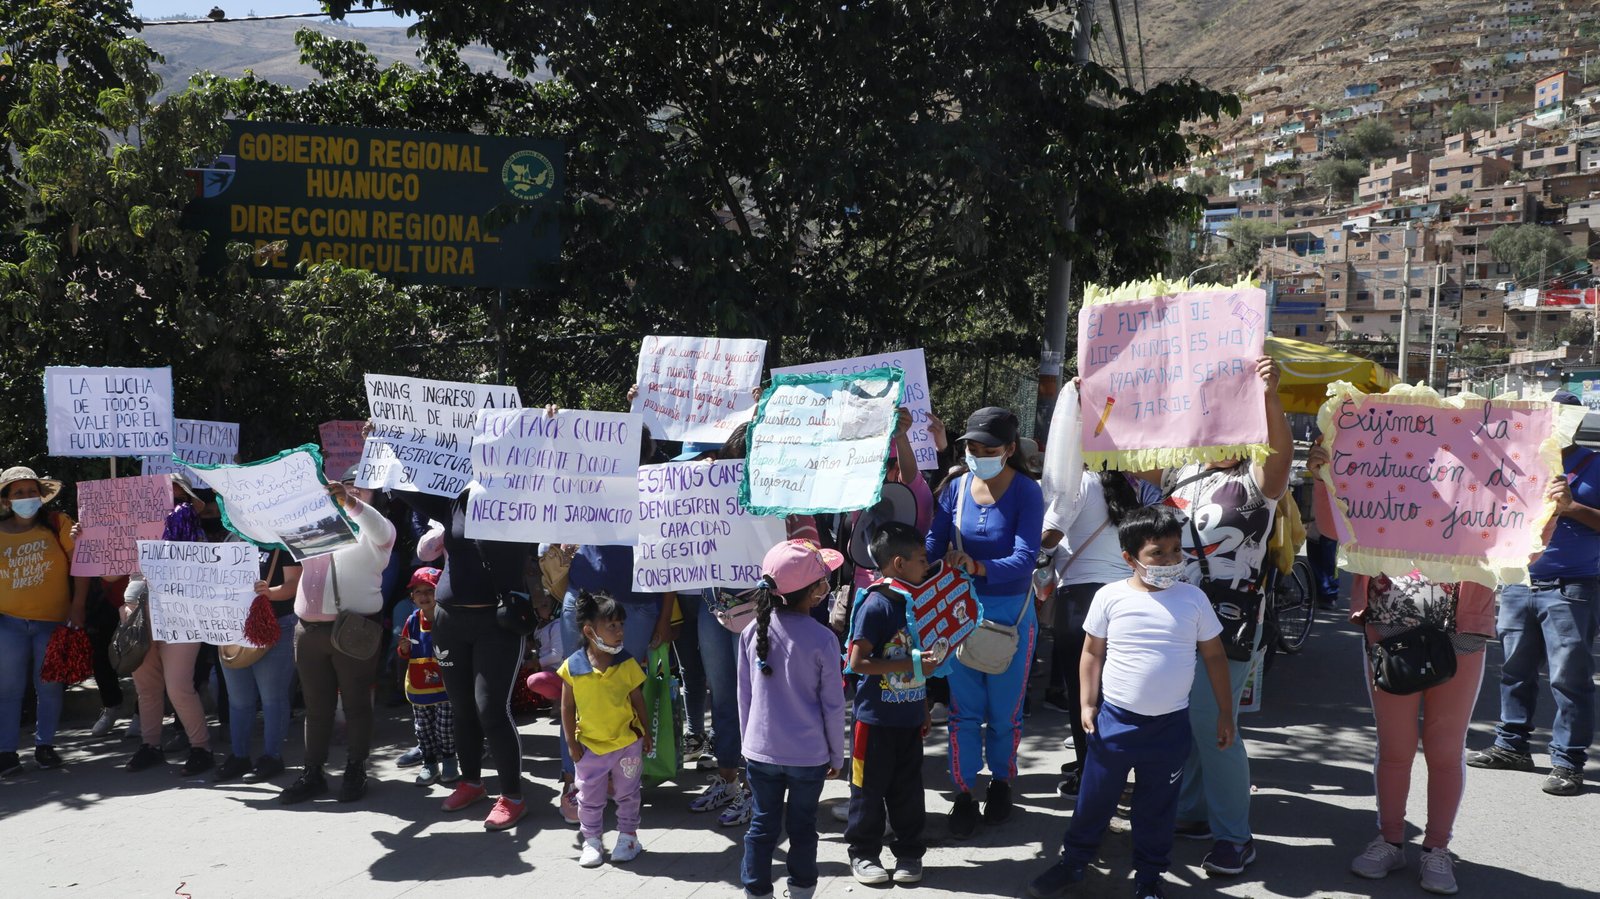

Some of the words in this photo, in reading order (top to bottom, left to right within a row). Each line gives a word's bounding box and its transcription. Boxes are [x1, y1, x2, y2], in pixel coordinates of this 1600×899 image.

[239, 132, 360, 166] GOBIERNO
[369, 138, 489, 174] REGIONAL
[307, 168, 420, 201] HUANUCO
[510, 188, 544, 200] HUANUCO
[231, 204, 368, 238] DIRECCION
[299, 241, 476, 275] AGRICULTURA
[1087, 313, 1104, 340] EL
[1117, 306, 1180, 335] FUTURO
[1190, 301, 1213, 321] DE
[1090, 344, 1120, 366] LOS
[1131, 336, 1182, 360] NIÑOS
[1189, 332, 1208, 352] ES
[1218, 328, 1256, 348] HOY
[69, 377, 92, 395] LA
[105, 377, 155, 394] LUCHA
[1110, 365, 1183, 394] MAÑANA
[1192, 359, 1245, 384] SERA
[74, 399, 89, 414] DE
[101, 396, 149, 411] TODOS
[422, 386, 476, 408] INGRESO
[483, 392, 495, 409] A
[1131, 395, 1193, 420] TARDE
[73, 415, 109, 430] VALE
[116, 412, 140, 428] POR
[143, 412, 160, 427] EL
[372, 400, 417, 423] CAPITAL
[427, 408, 443, 426] DE
[1338, 399, 1437, 445] Exijimos
[1471, 401, 1511, 440] la
[70, 432, 115, 449] FUTURO
[371, 423, 405, 440] URGE
[410, 427, 428, 444] DE
[435, 432, 458, 452] UNA
[482, 415, 516, 439] POR
[519, 415, 567, 440] FAVOR
[573, 417, 629, 445] QUIERO
[481, 444, 500, 467] UN
[505, 445, 569, 470] AMBIENTE
[577, 452, 621, 475] DONDE
[399, 466, 418, 484] SU
[479, 472, 496, 489] ME
[503, 472, 547, 492] SIENTA
[637, 464, 703, 493] ESTAMOS
[1484, 458, 1518, 488] de
[144, 499, 165, 512] PARA
[471, 499, 537, 522] NECESITO
[543, 504, 557, 523] MI
[564, 504, 633, 525] JARDINCITO
[639, 497, 720, 521] DEMUESTREN
[1337, 490, 1422, 522] nuestro
[660, 520, 731, 539] CAPACIDAD
[4, 547, 12, 558] A
[17, 540, 48, 556] COOL
[9, 551, 44, 568] WOMAN
[141, 543, 221, 564] FUNCIONARIOS
[231, 546, 251, 565] DE
[642, 543, 656, 560] DE
[661, 538, 718, 560] GESTION
[13, 568, 19, 579] A
[23, 560, 54, 578] BLACK
[196, 566, 260, 585] DEMUESTREN
[636, 565, 708, 588] CONSTRUYAN
[711, 563, 726, 581] EL
[13, 575, 44, 589] DRESS
[156, 582, 216, 600] CAPACIDAD
[224, 587, 240, 601] DE
[186, 630, 202, 641] DE
